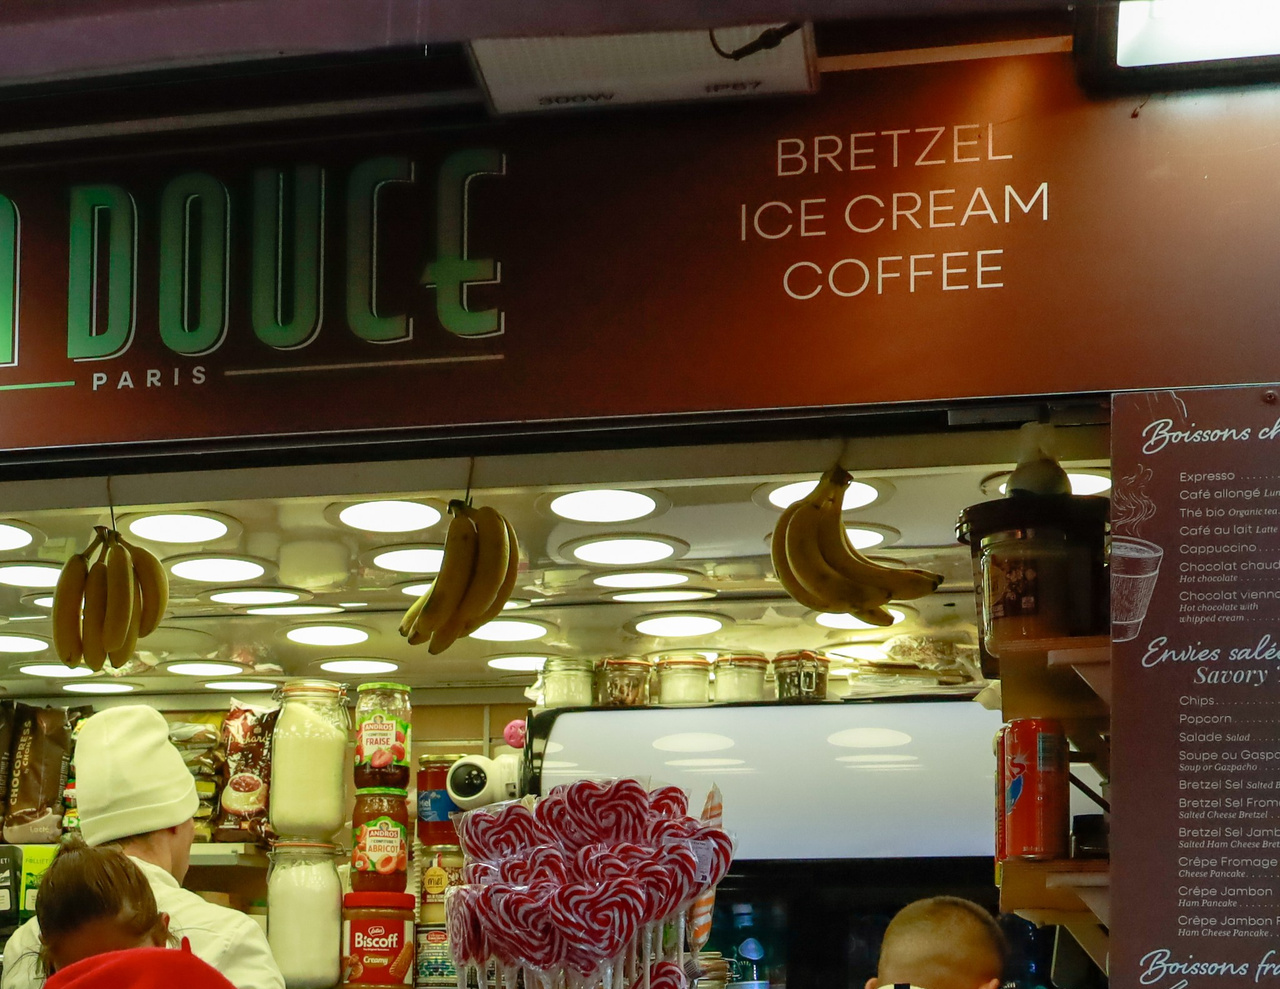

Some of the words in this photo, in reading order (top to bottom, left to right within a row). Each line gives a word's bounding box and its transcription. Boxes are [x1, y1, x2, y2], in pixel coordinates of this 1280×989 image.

[778, 121, 1015, 178] BRETZEL
[742, 198, 826, 240] ICE
[845, 182, 1047, 232] CREAM
[65, 148, 507, 363] DOUCE
[784, 249, 1003, 299] COFFEE
[91, 365, 208, 391] PARIS
[1142, 419, 1251, 454] Boissons
[1180, 472, 1235, 483] Expresso
[1180, 489, 1210, 500] Café
[1214, 488, 1260, 500] allongé
[1180, 508, 1202, 517] Thé
[1206, 508, 1225, 517] bio
[1228, 508, 1262, 518] Organic
[1180, 525, 1210, 536] Café
[1214, 527, 1230, 535] au
[1234, 525, 1252, 534] lait
[1180, 544, 1256, 555] Cappuccino
[1180, 562, 1237, 572] Chocolat
[1241, 560, 1280, 570] chaud
[1179, 591, 1237, 601] Chocolat
[1142, 637, 1220, 667] Envies
[1194, 667, 1268, 686] Savory
[1180, 696, 1214, 707] Chips
[1180, 714, 1231, 725] Popcorn
[364, 722, 394, 731] ANDROS
[365, 737, 391, 746] FRAISE
[1180, 732, 1222, 742] Salade
[22, 736, 33, 767] CHOKY
[1179, 751, 1218, 761] Soupe
[1222, 752, 1237, 760] ou
[10, 720, 32, 805] CHOCOPRESS
[1180, 780, 1221, 789] Bretzel
[1225, 780, 1243, 789] Sel
[1179, 798, 1221, 808] Bretzel
[1225, 798, 1242, 807] Sel
[369, 830, 398, 838] ANDROS
[1179, 827, 1221, 837] Bretzel
[1225, 827, 1242, 837] Sel
[368, 844, 399, 853] ABRICOT
[1179, 857, 1217, 868] Crêpe
[1221, 857, 1278, 868] Fromage
[1178, 886, 1217, 897] Crêpe
[1221, 886, 1272, 896] Jambon
[1178, 916, 1217, 927] Crêpe
[1221, 916, 1272, 925] Jambon
[354, 932, 399, 948] Biscoff
[363, 955, 389, 966] Creamy
[1140, 949, 1249, 986] Boissons
